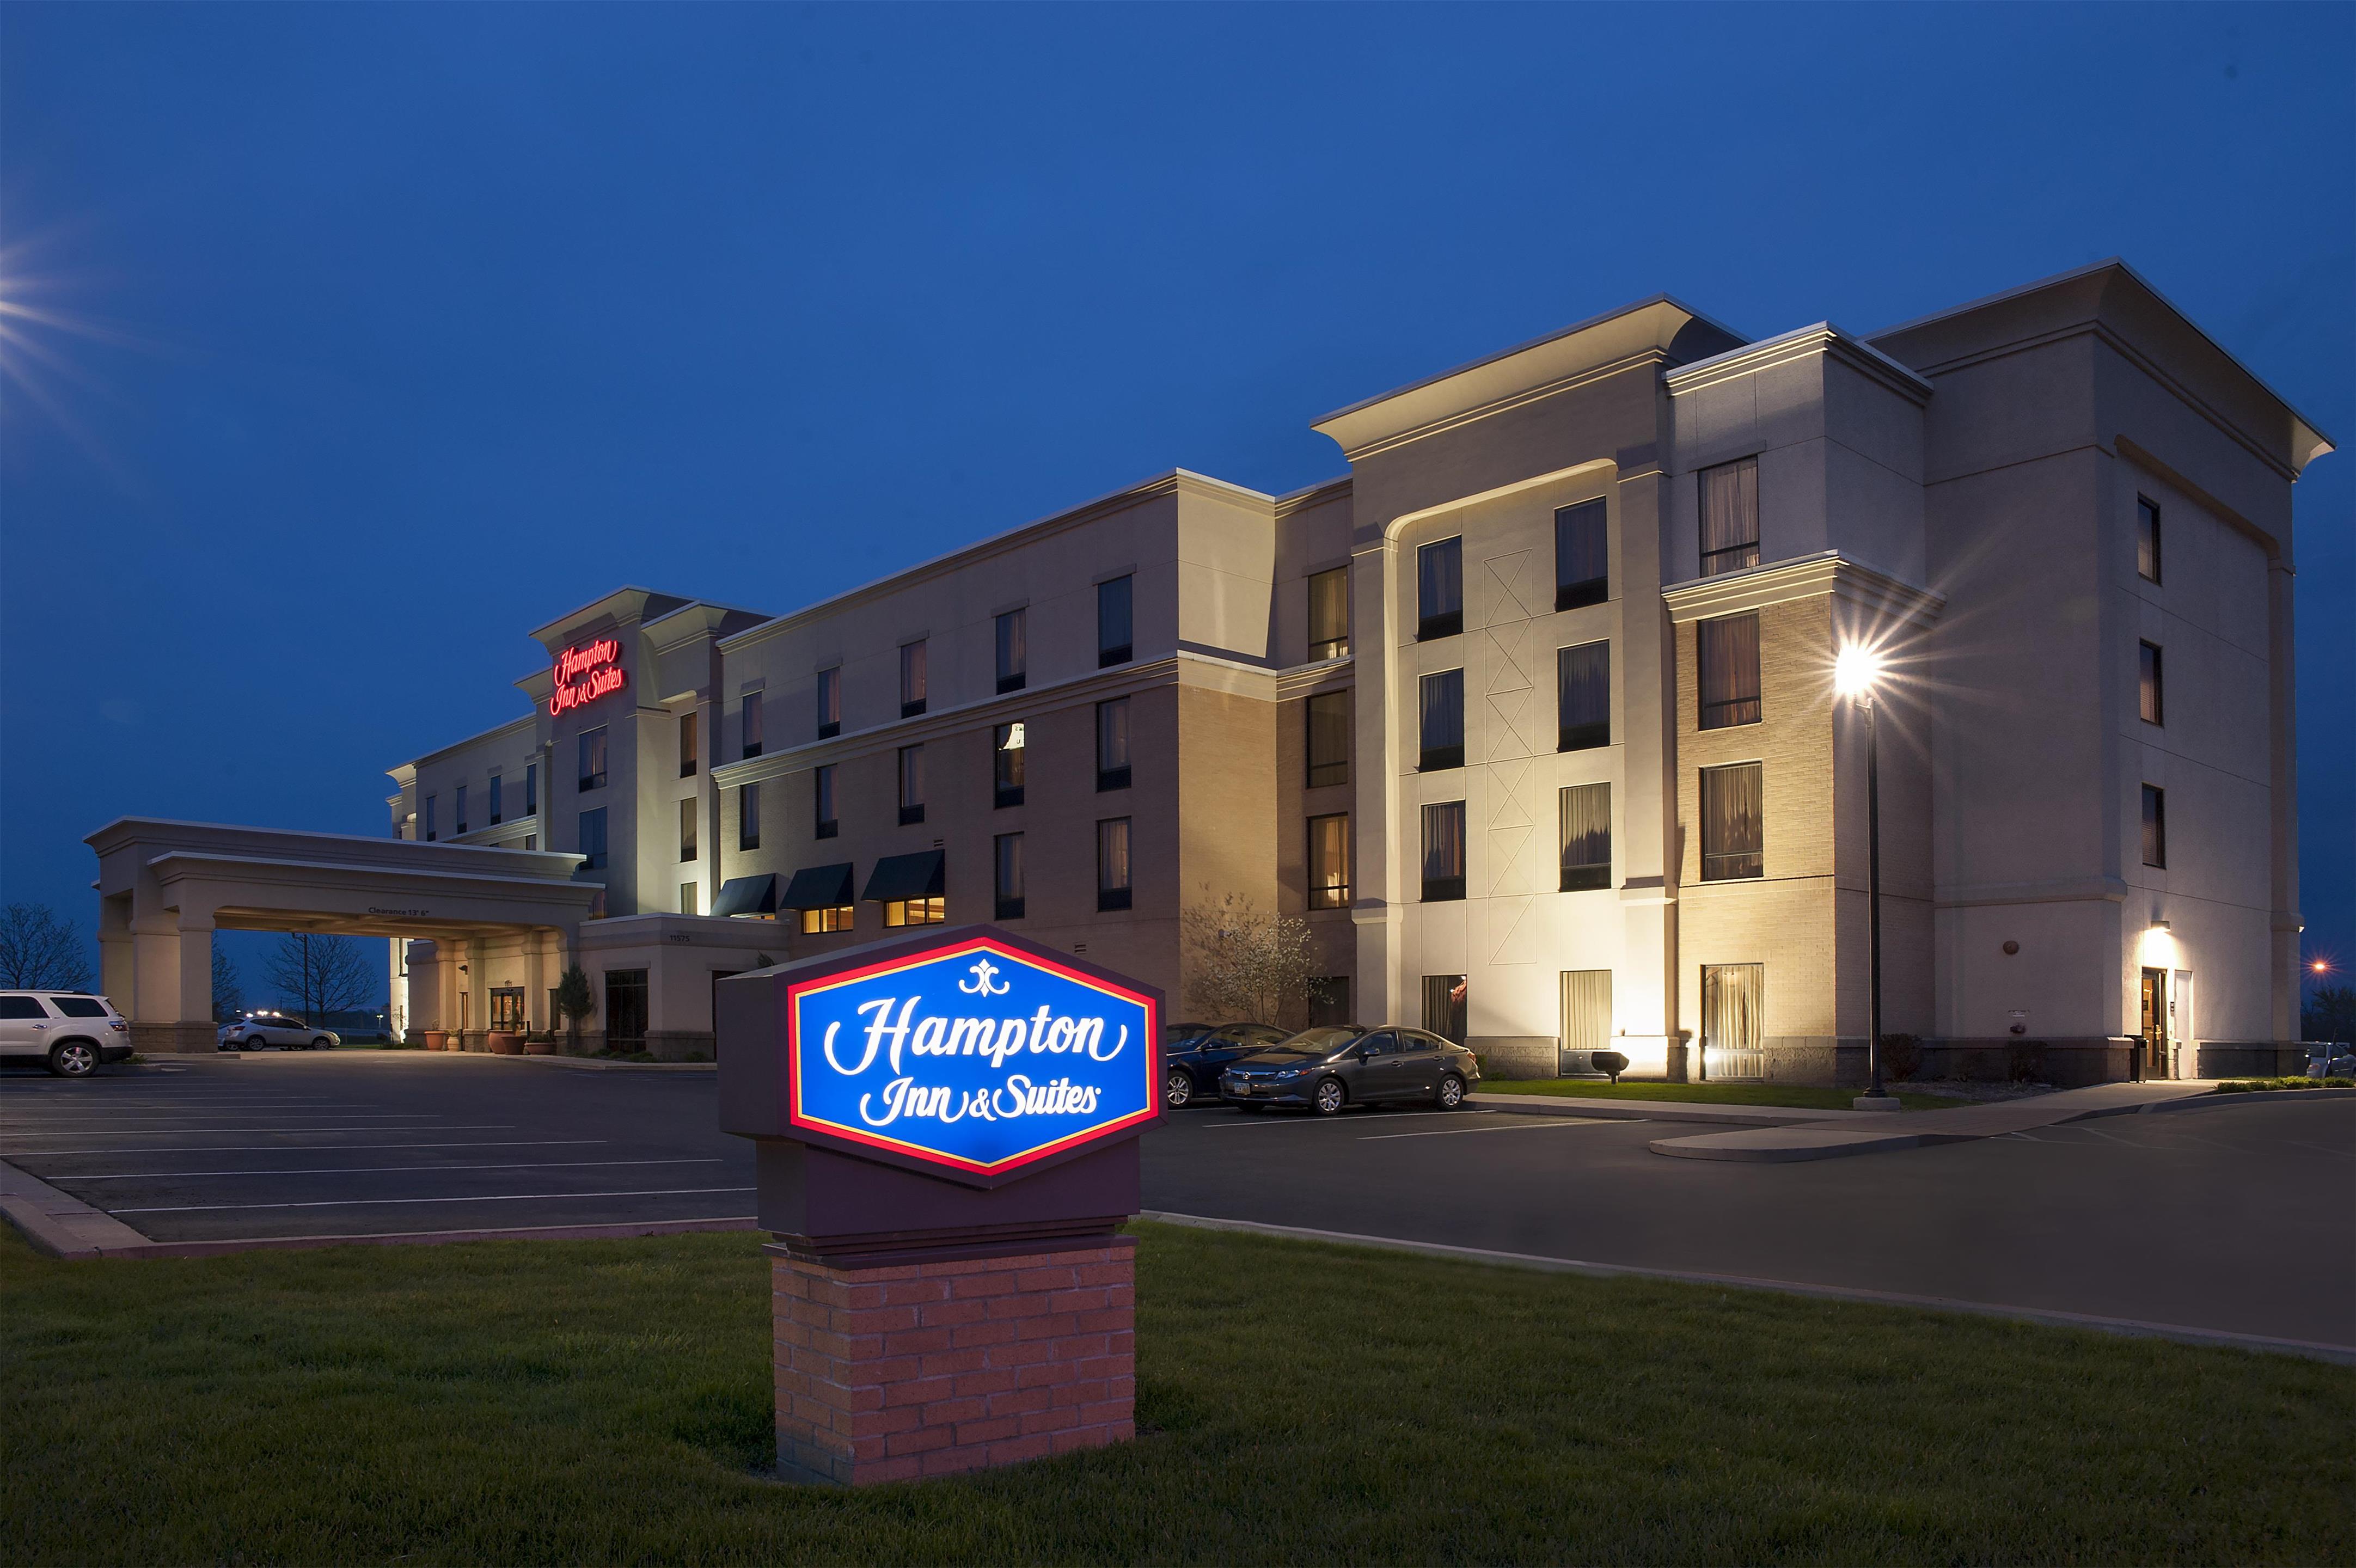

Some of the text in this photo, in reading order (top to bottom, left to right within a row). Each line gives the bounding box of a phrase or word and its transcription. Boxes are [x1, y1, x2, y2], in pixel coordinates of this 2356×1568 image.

[554, 640, 618, 687] Hampton
[550, 666, 622, 716] Inn & Suites
[368, 906, 407, 915] Clearance
[824, 995, 1128, 1075] Hampton
[860, 1074, 1098, 1126] Inn & Suites
